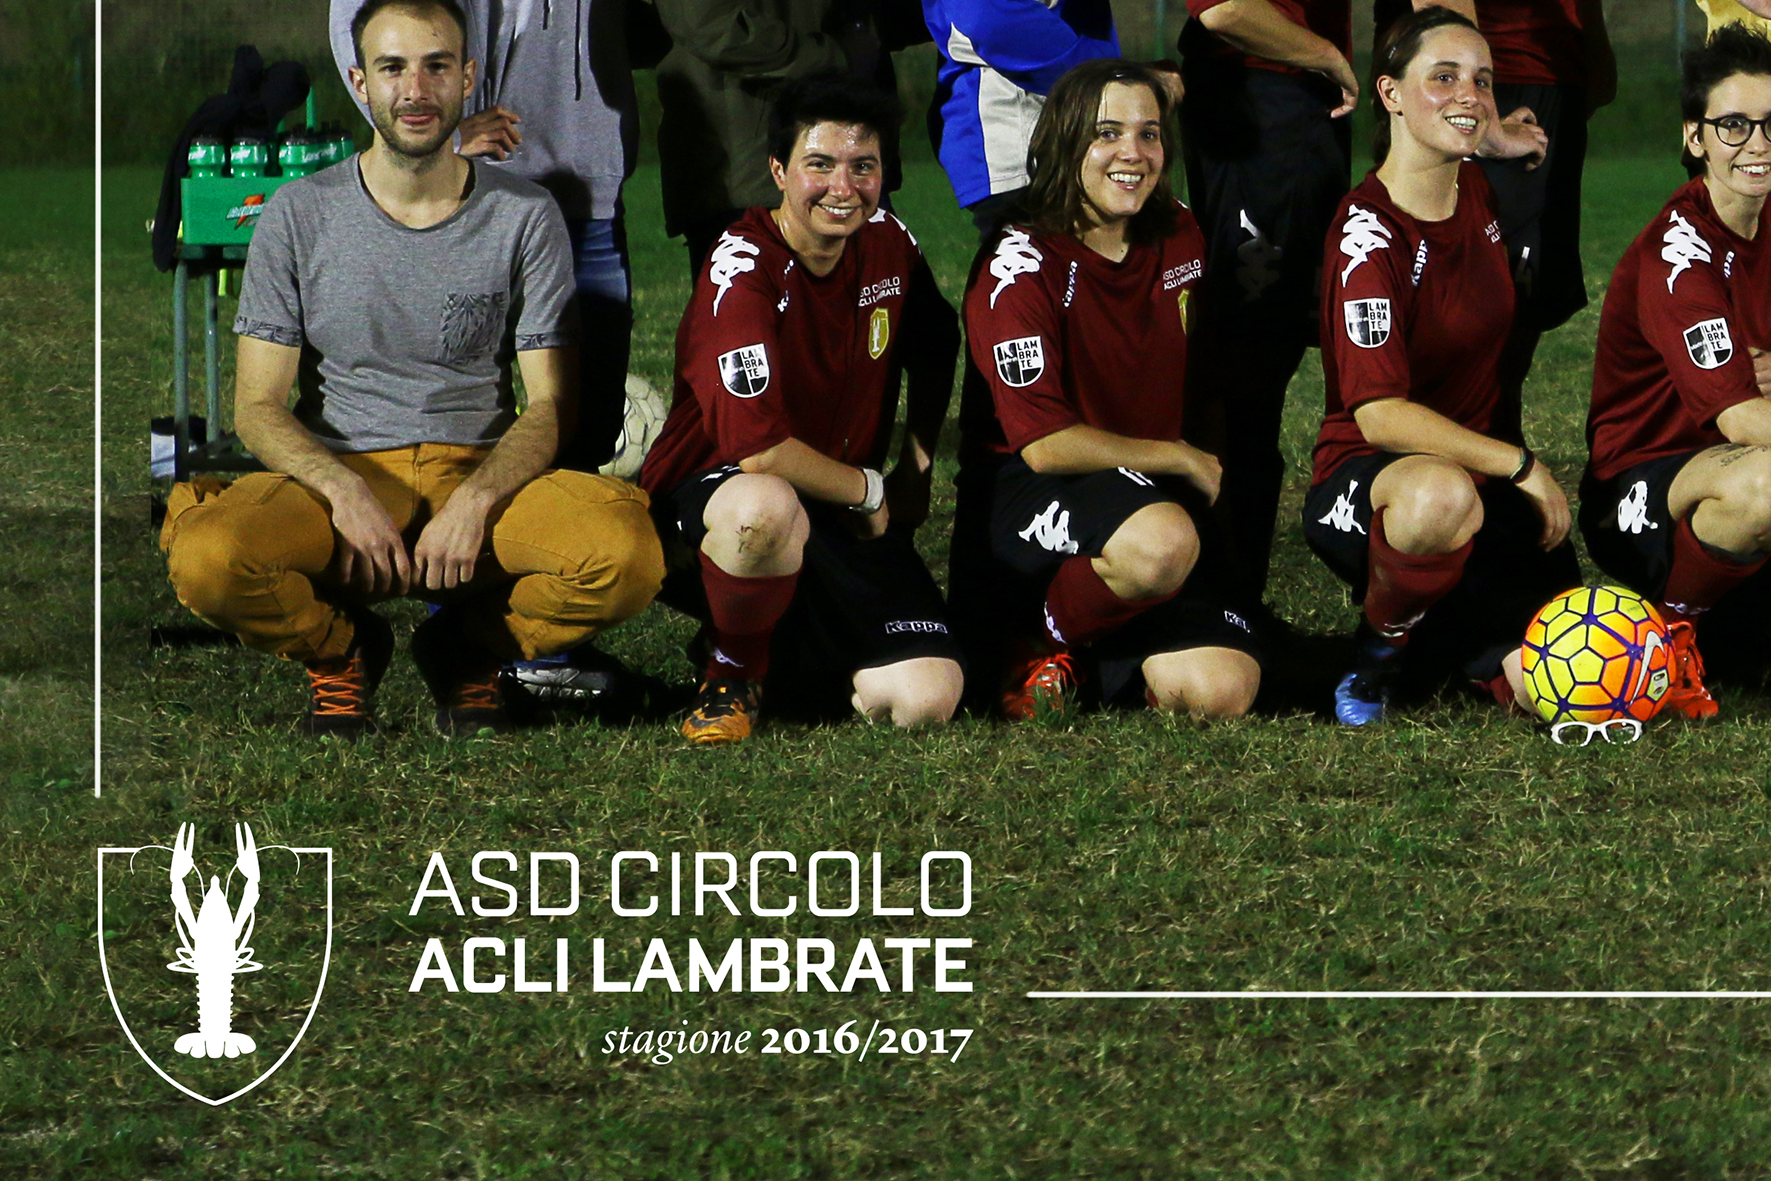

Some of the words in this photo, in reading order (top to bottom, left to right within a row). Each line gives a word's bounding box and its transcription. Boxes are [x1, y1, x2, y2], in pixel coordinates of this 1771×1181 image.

[1410, 239, 1428, 287] Kapp
[741, 348, 759, 360] LA
[885, 619, 949, 635] Kappa
